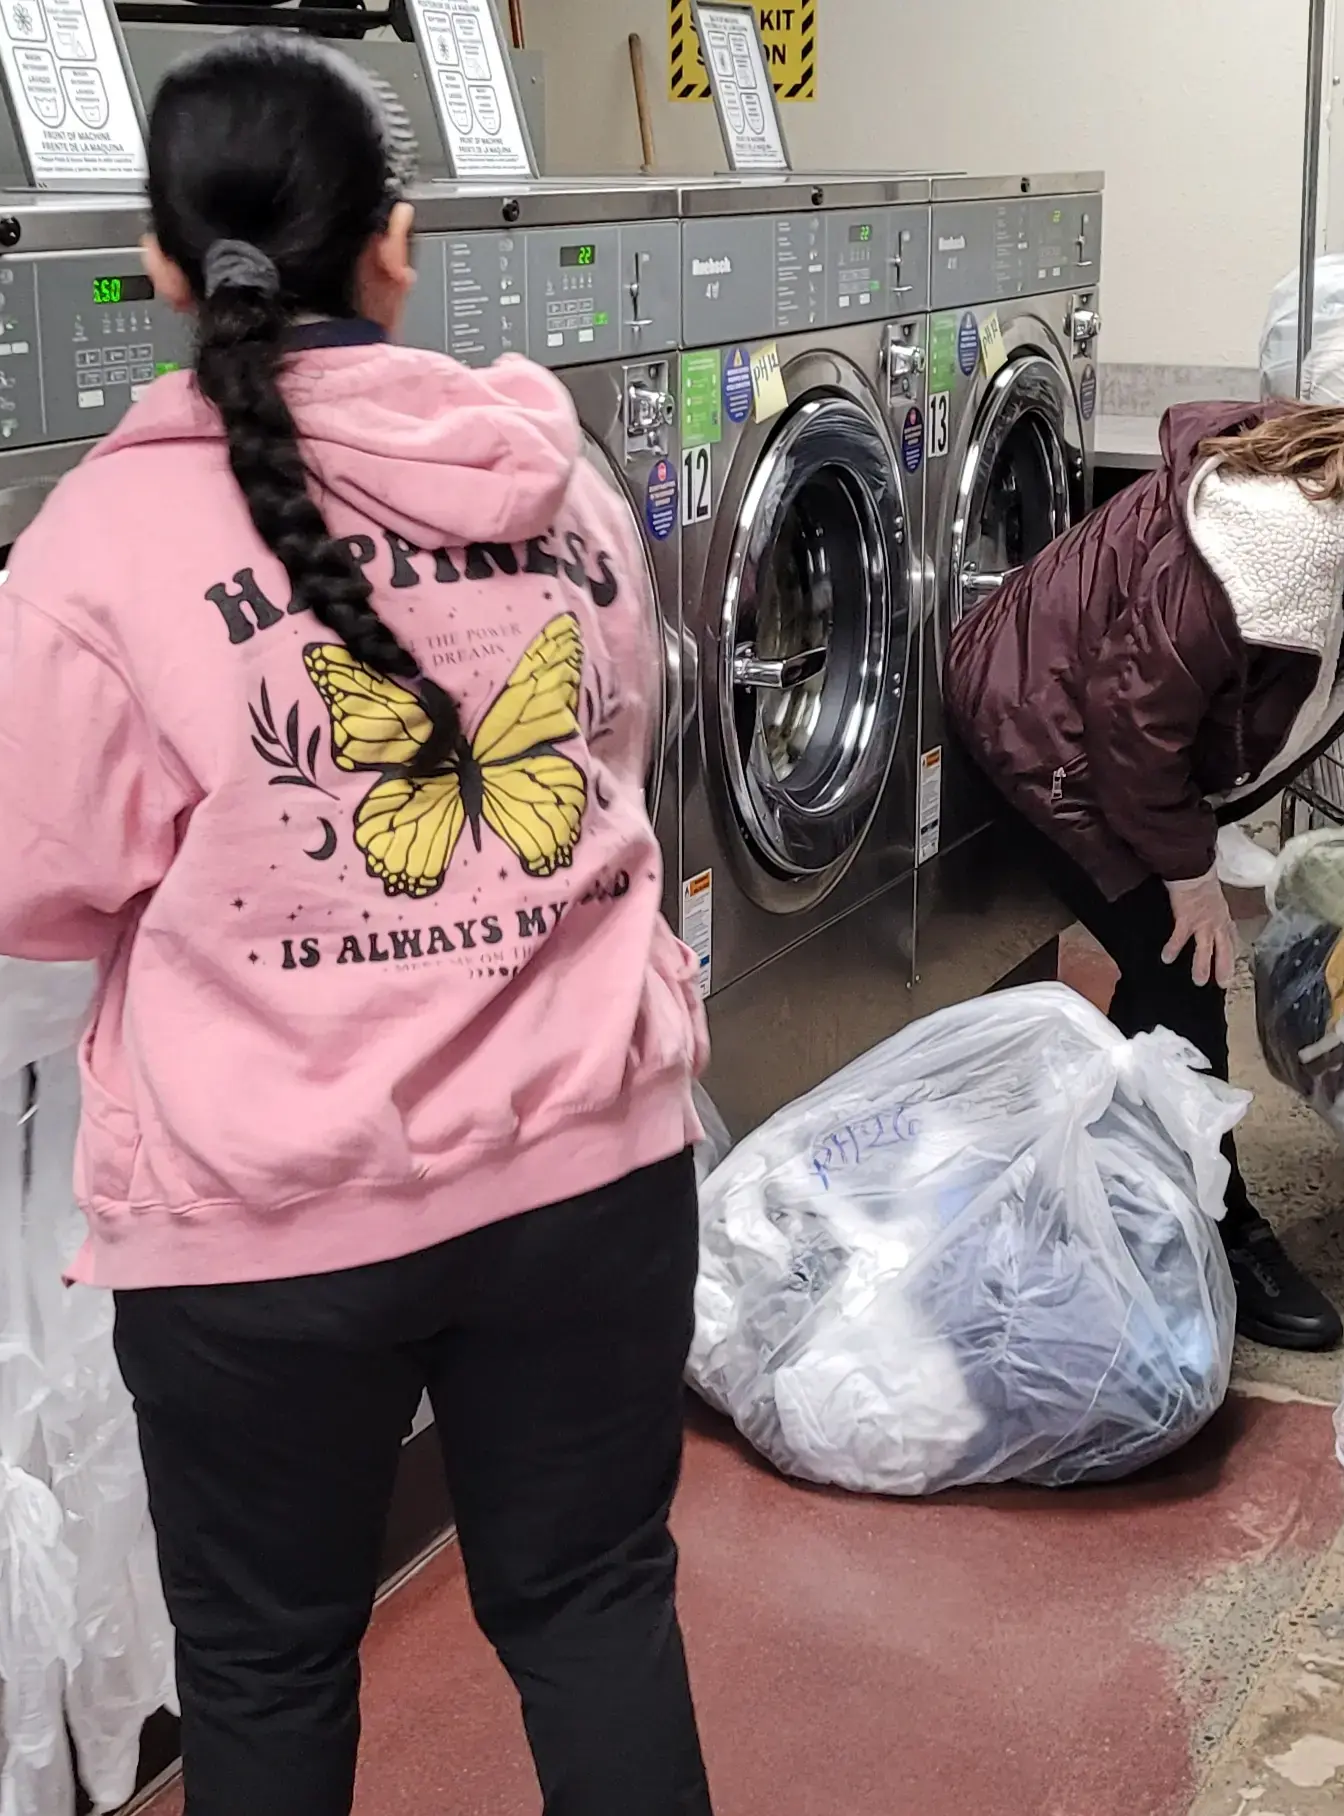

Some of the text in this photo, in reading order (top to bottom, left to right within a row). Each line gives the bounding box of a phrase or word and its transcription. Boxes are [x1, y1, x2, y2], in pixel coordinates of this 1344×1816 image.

[760, 9, 795, 31] KIT
[577, 246, 592, 265] 22
[929, 395, 948, 454] 13
[684, 447, 710, 520] 12
[280, 901, 570, 970] IS ALWAYS MY
